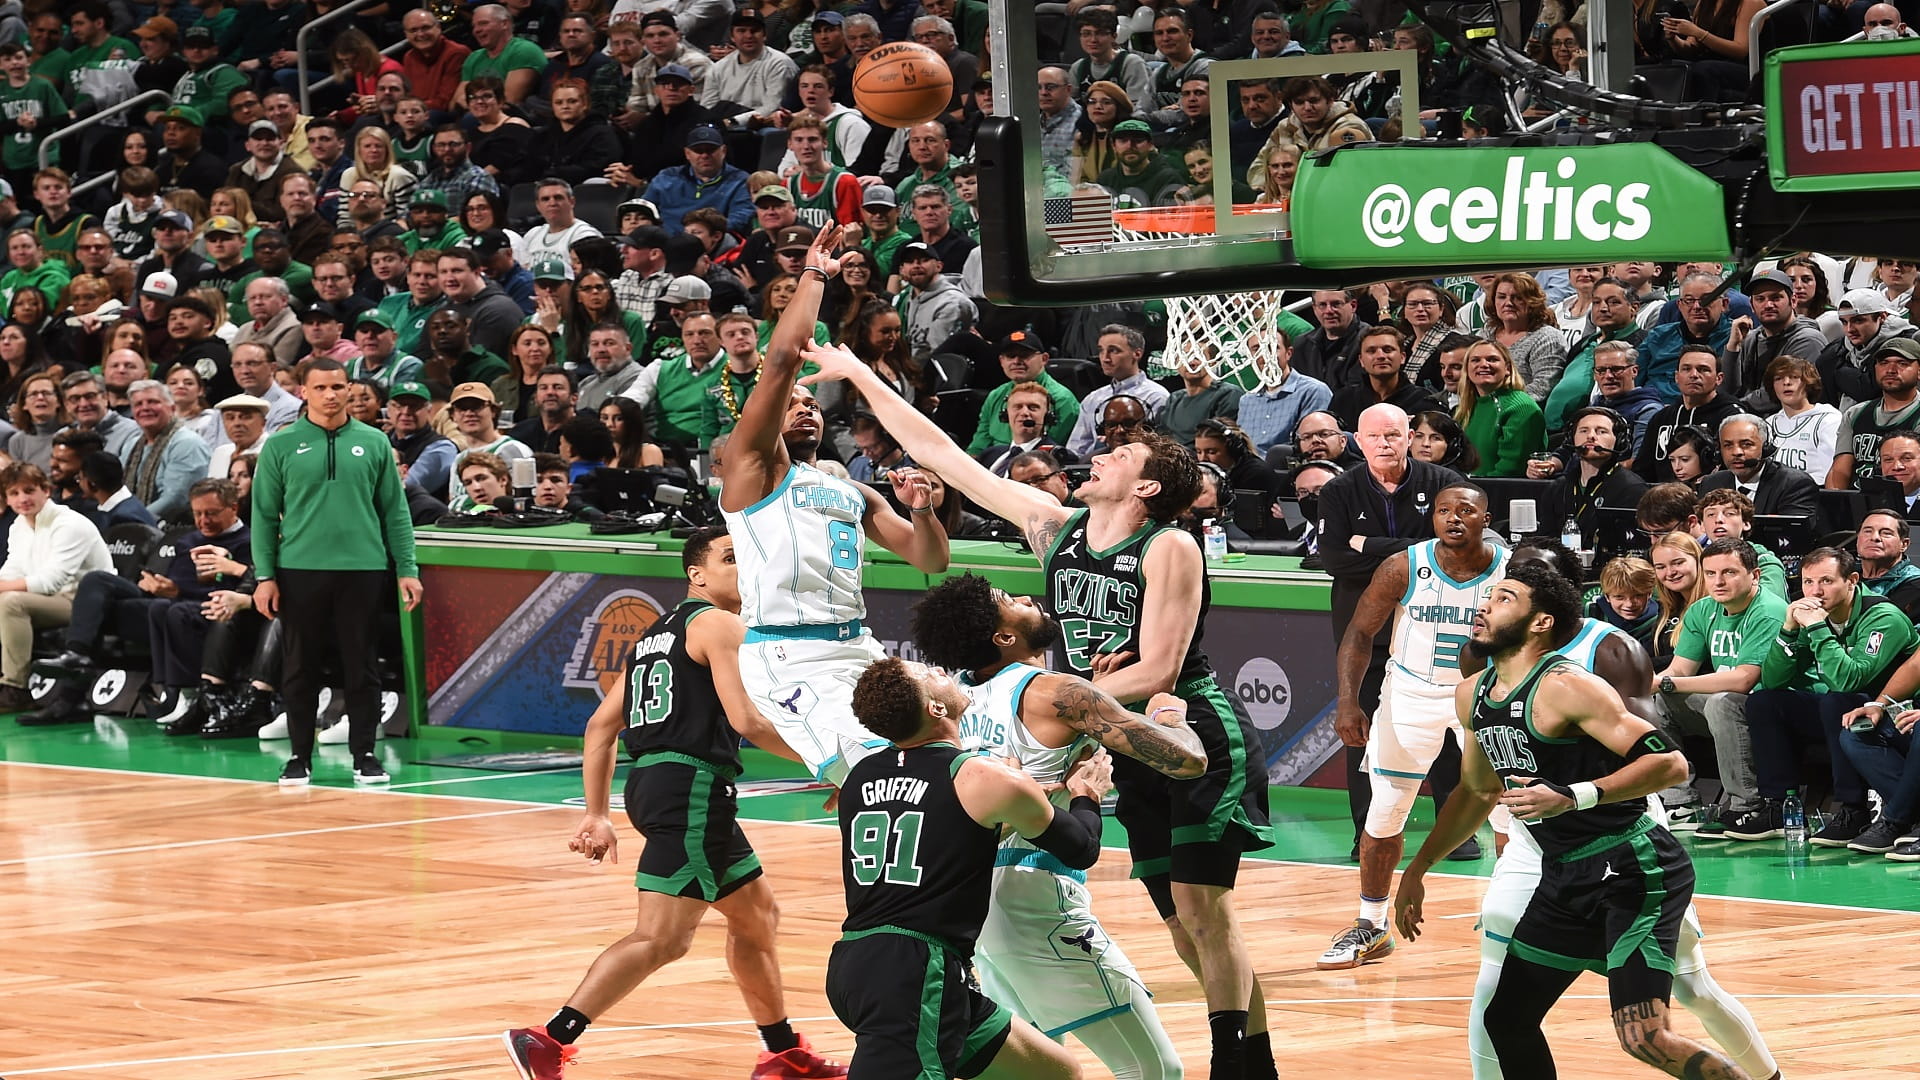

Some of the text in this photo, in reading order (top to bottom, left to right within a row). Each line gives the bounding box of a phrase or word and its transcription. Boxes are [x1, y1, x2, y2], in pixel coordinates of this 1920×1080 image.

[1801, 84, 1865, 154] GET
[1361, 155, 1652, 248] @celtics
[1780, 447, 1807, 471] TICS
[828, 519, 859, 571] 8
[1071, 528, 1084, 539] 6
[1113, 563, 1136, 573] PRINT
[1115, 555, 1138, 566] VISTA
[1420, 566, 1430, 580] 6
[1054, 568, 1138, 627] CELTICS
[611, 623, 636, 635] LOS
[1408, 605, 1477, 626] CHARLO
[635, 631, 677, 661] BROWN
[1433, 632, 1472, 670] 3
[629, 658, 674, 729] 13
[1239, 677, 1288, 705] abc
[1644, 735, 1666, 752] 0
[861, 776, 930, 806] GRIFFIN
[850, 810, 925, 887] 91
